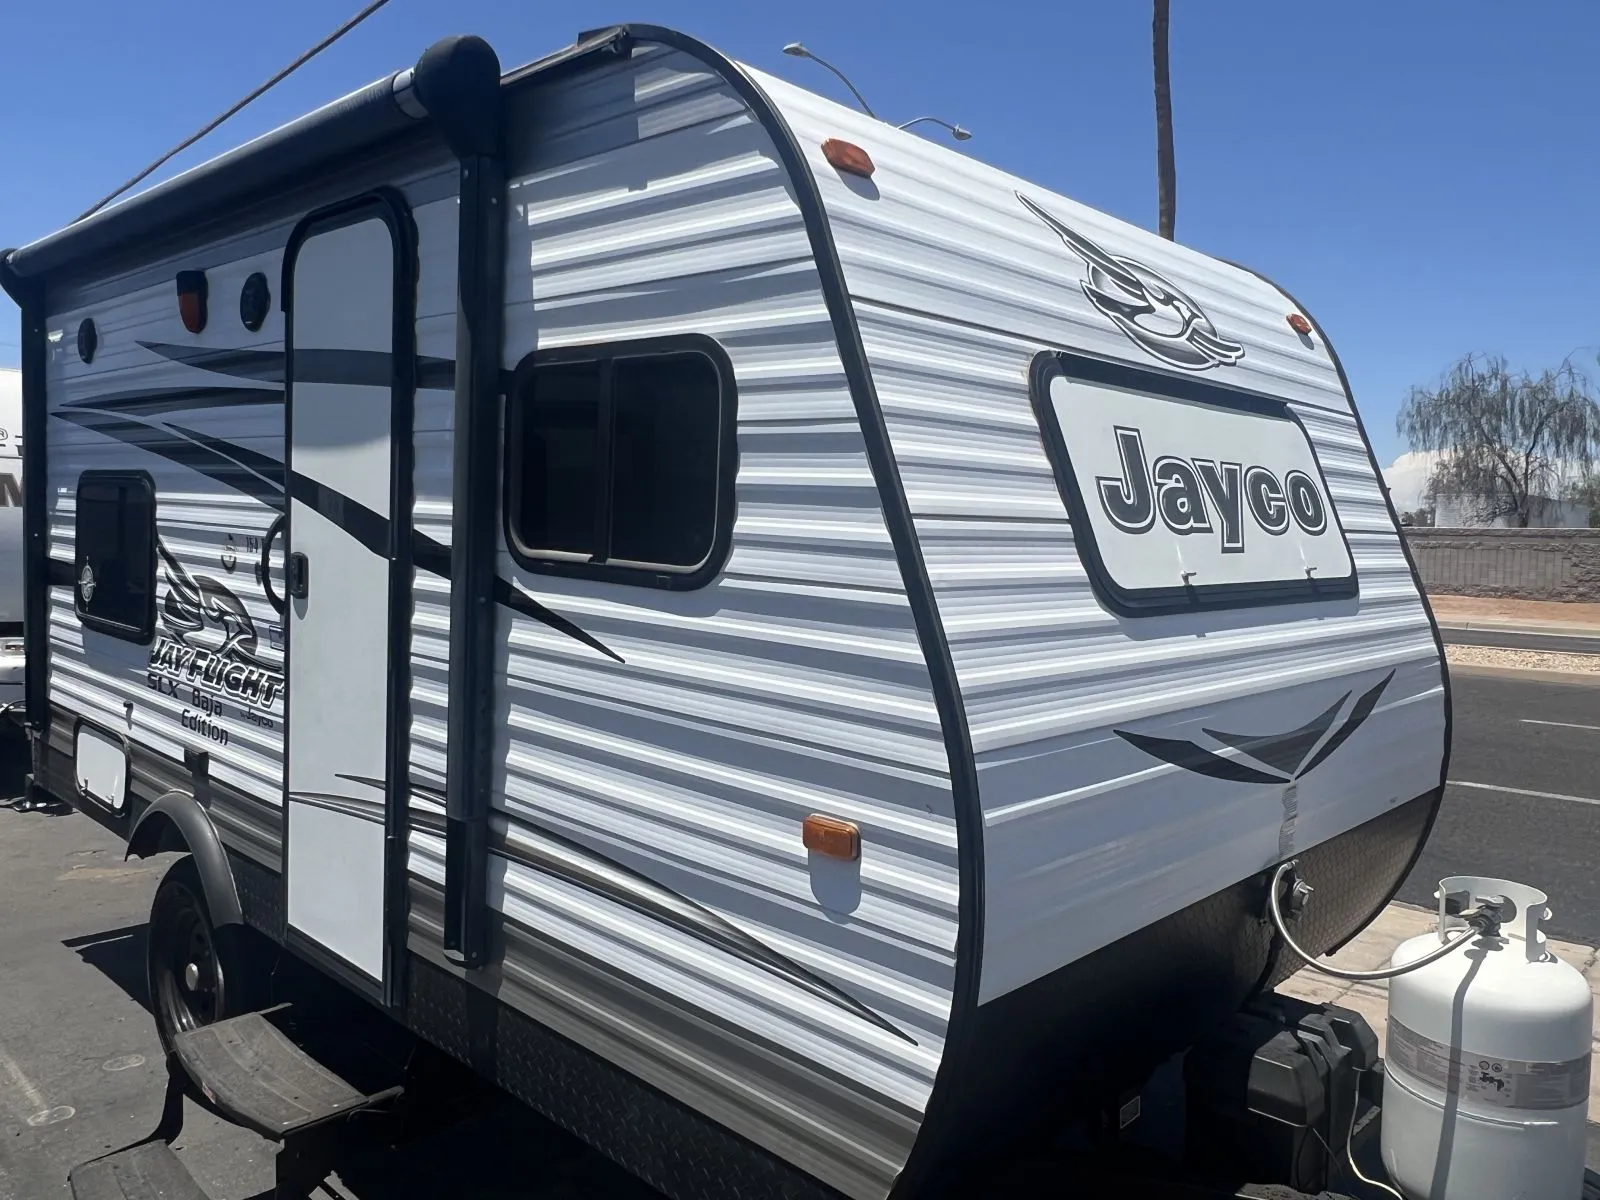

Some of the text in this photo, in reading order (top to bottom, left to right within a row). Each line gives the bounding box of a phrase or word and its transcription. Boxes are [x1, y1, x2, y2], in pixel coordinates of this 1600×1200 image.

[1095, 424, 1327, 553] Jayco
[147, 672, 223, 717] SLX Baja
[182, 708, 229, 746] Edition
